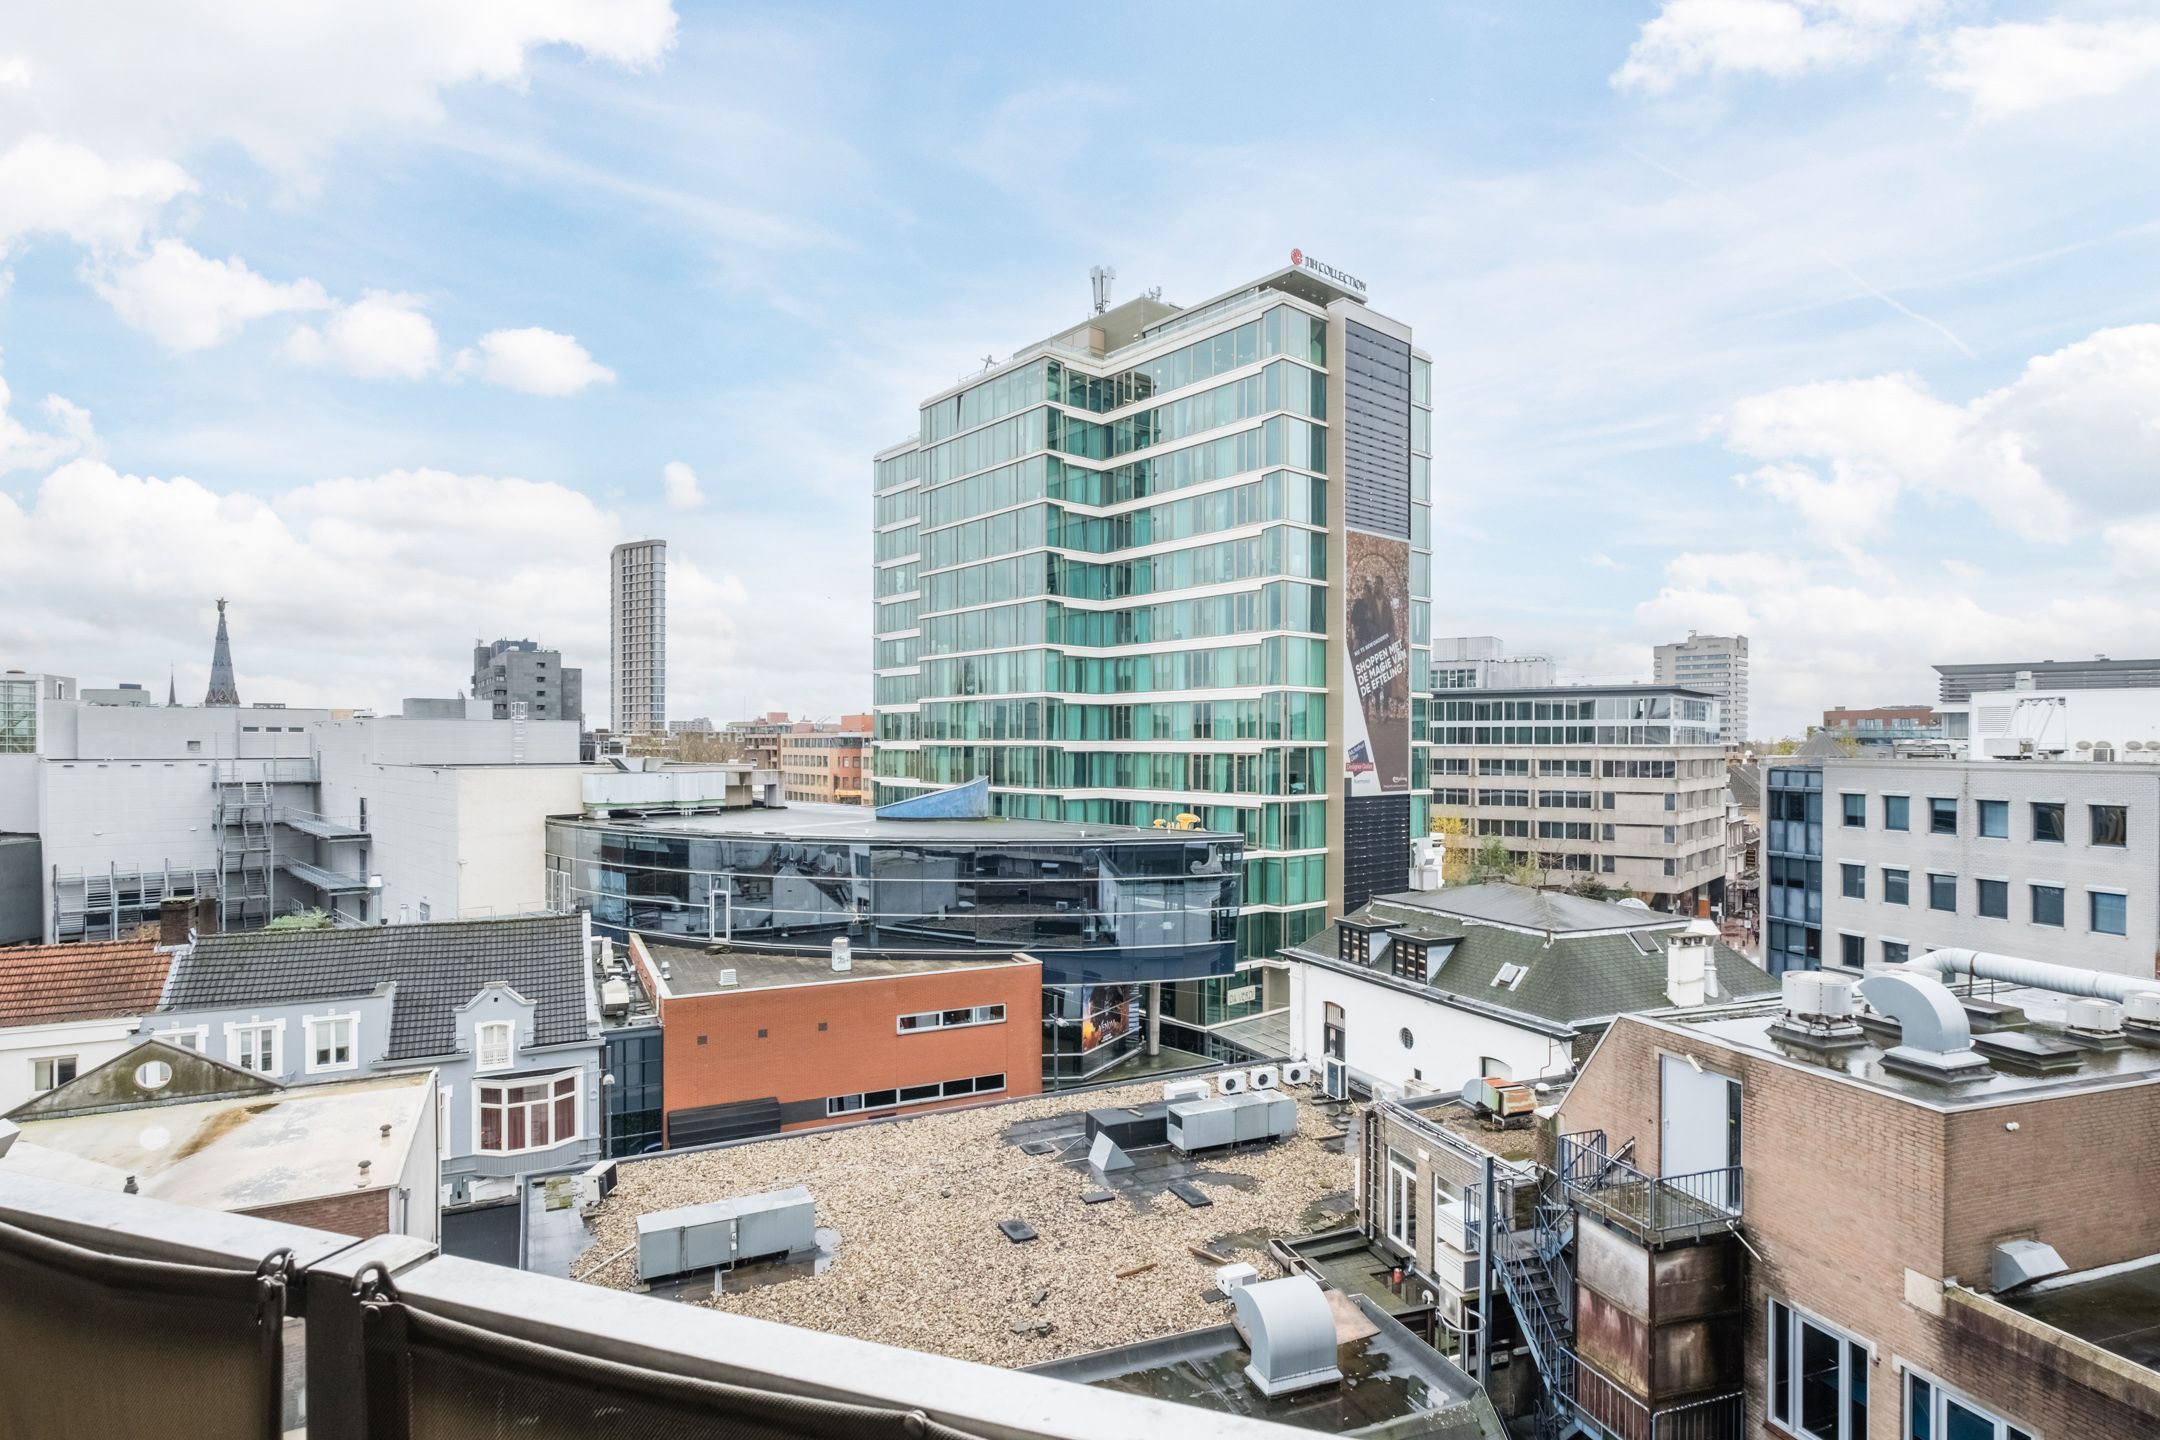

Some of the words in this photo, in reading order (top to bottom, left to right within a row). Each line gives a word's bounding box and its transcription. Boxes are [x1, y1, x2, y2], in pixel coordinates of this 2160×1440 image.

[1319, 262, 1367, 292] COLLECTION
[1355, 647, 1388, 675] SHOPPEN
[1388, 639, 1403, 656] MET
[1357, 672, 1369, 686] DE
[1368, 658, 1392, 680] MAGIE
[1392, 648, 1407, 664] VAN
[1360, 682, 1371, 698] DE
[1371, 663, 1403, 690] EFTELING
